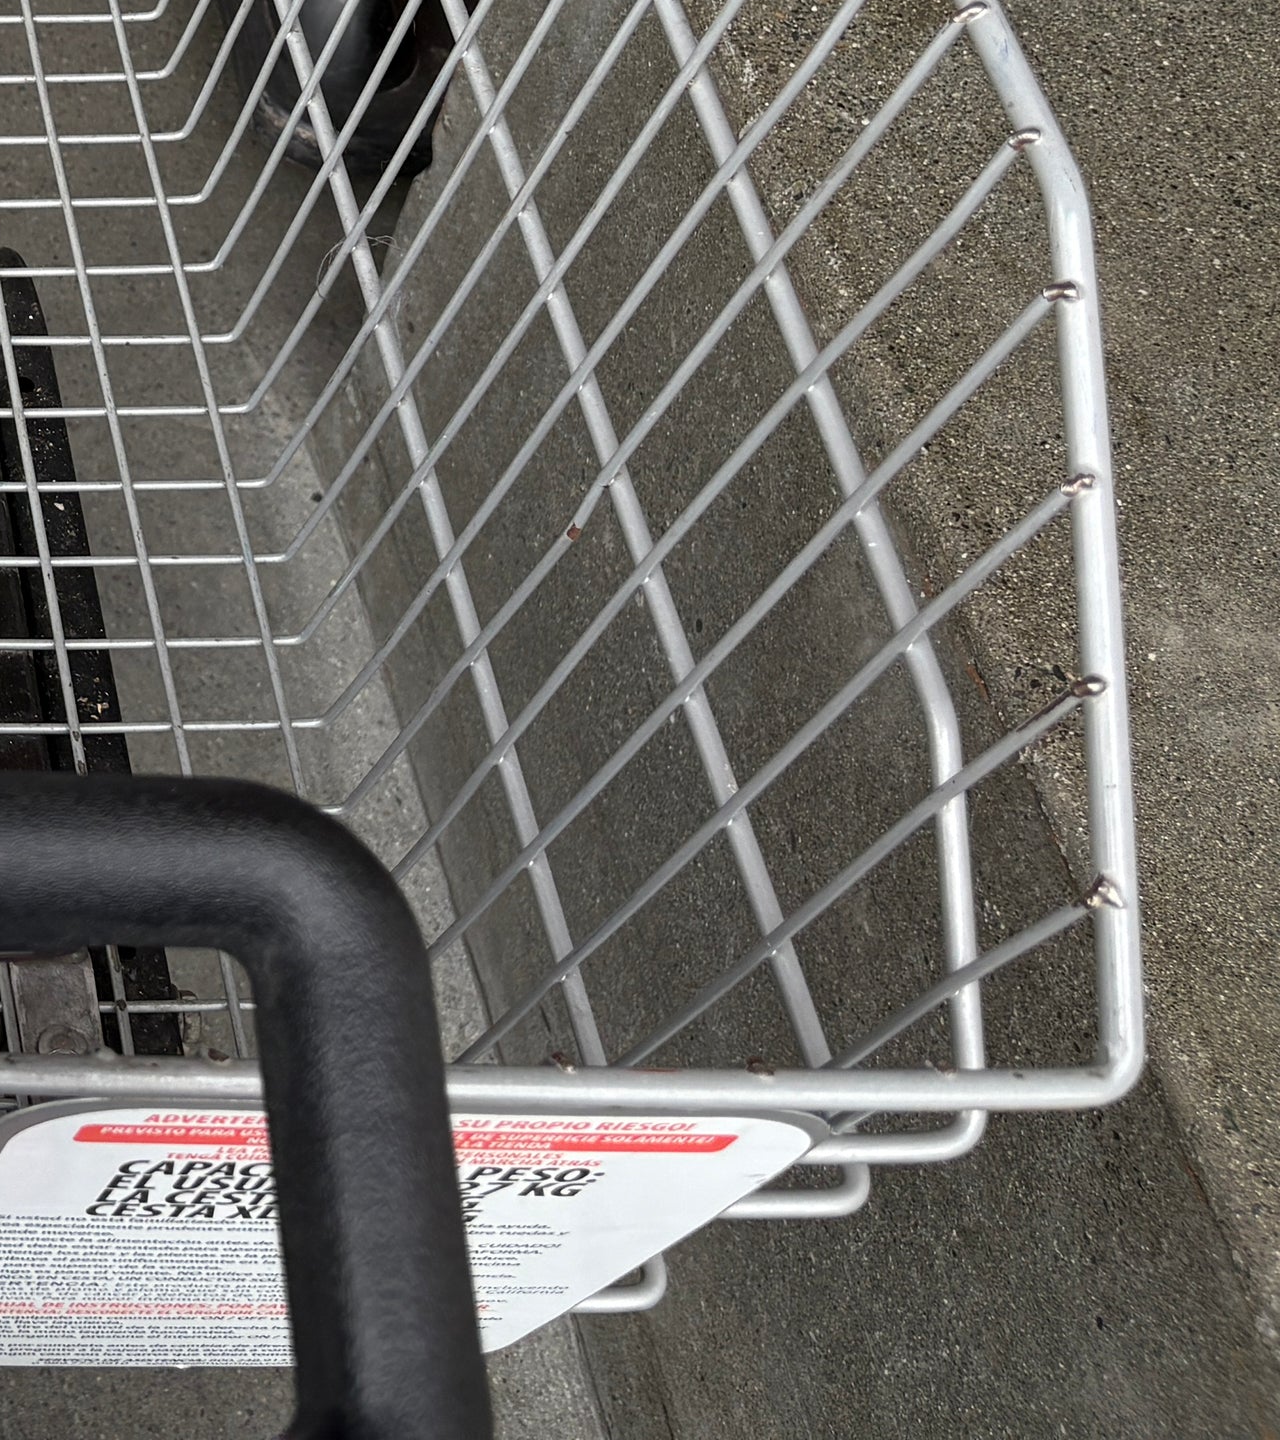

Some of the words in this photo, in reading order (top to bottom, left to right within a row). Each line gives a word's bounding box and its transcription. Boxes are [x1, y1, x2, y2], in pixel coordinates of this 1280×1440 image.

[454, 1119, 490, 1128] SU
[494, 1120, 591, 1130] PROPIO
[595, 1122, 698, 1131] RIESGO!
[189, 1128, 236, 1136] PARA
[499, 1134, 598, 1142] SUPERFICIE
[602, 1136, 714, 1144] SOLAMENTE!
[466, 1166, 605, 1183] PESO:
[106, 1175, 156, 1189] EL
[518, 1182, 587, 1196] KG
[95, 1189, 149, 1203] LA
[85, 1203, 216, 1218] CESTA
[226, 1205, 280, 1219] XL
